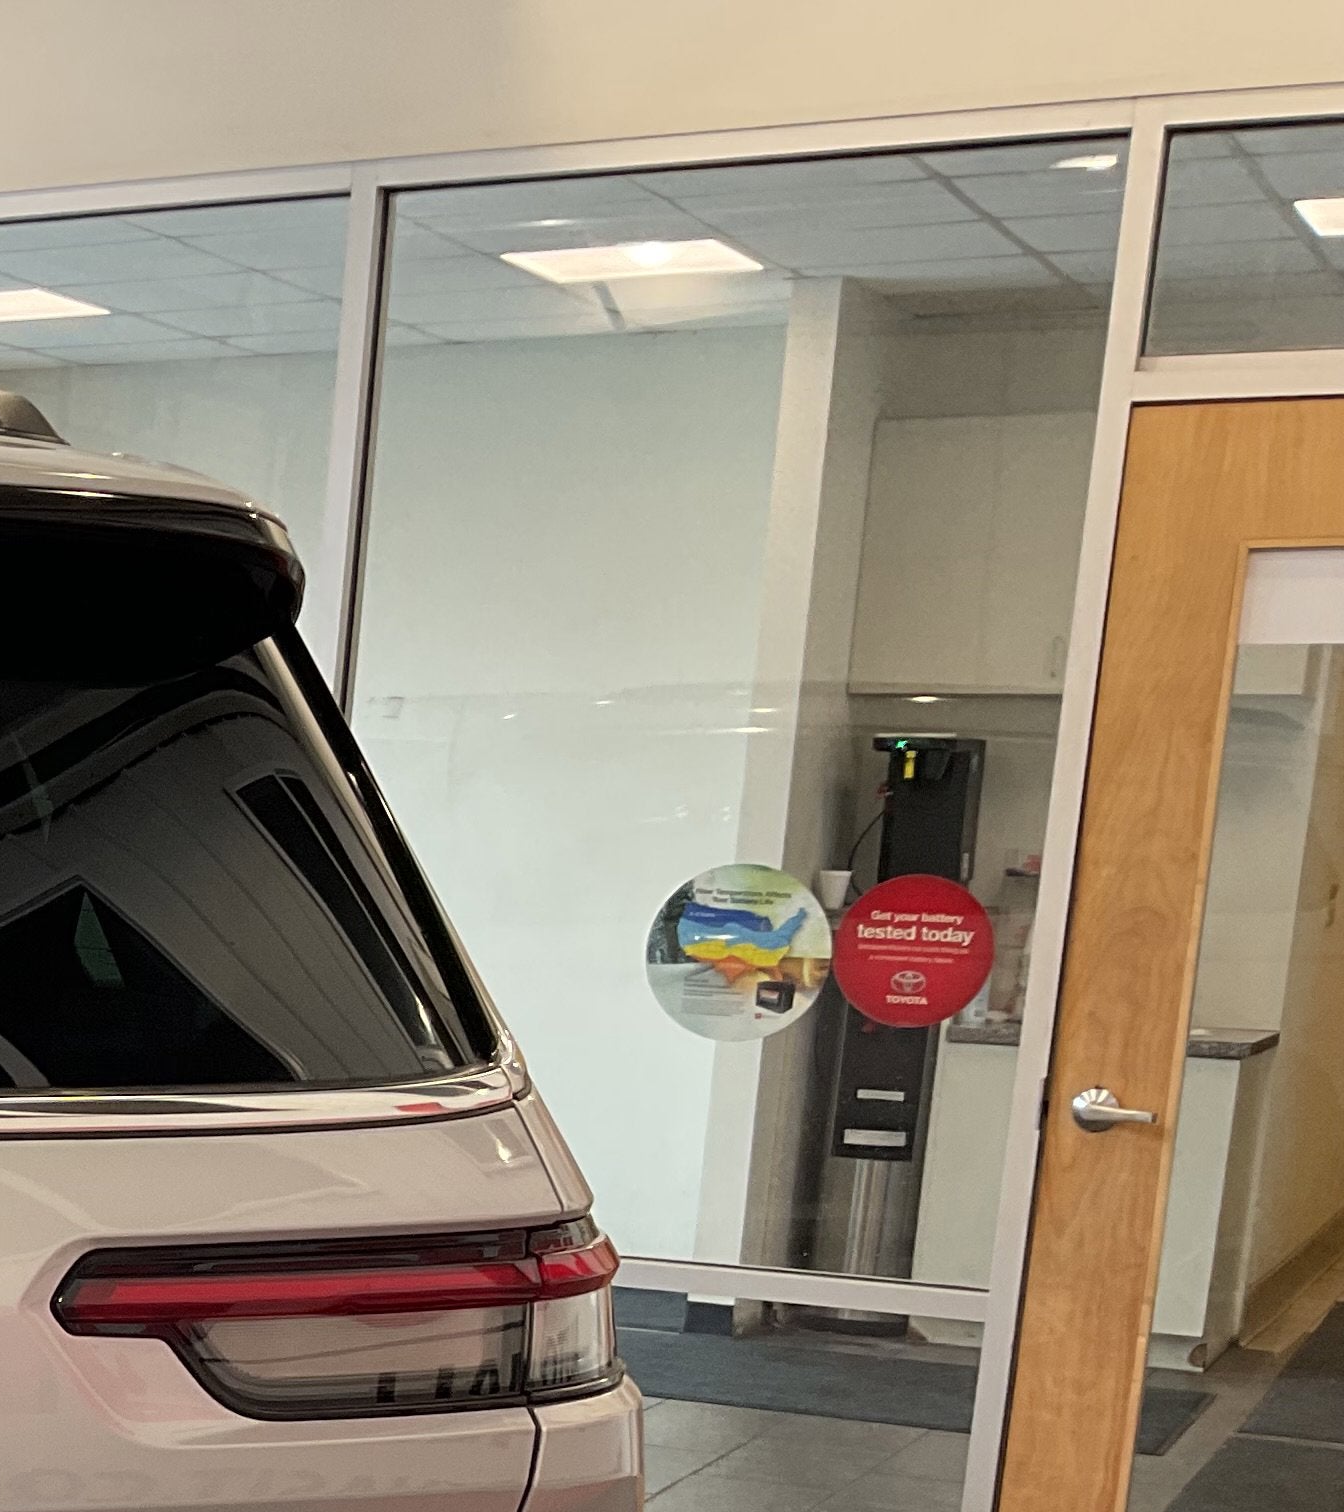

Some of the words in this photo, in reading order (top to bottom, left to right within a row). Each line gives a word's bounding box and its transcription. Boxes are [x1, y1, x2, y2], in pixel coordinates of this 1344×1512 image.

[871, 910, 892, 921] Get
[893, 913, 920, 923] your
[921, 912, 965, 926] battery
[857, 924, 917, 941] tested
[922, 927, 975, 947] today
[885, 994, 929, 1005] TOYOTA
